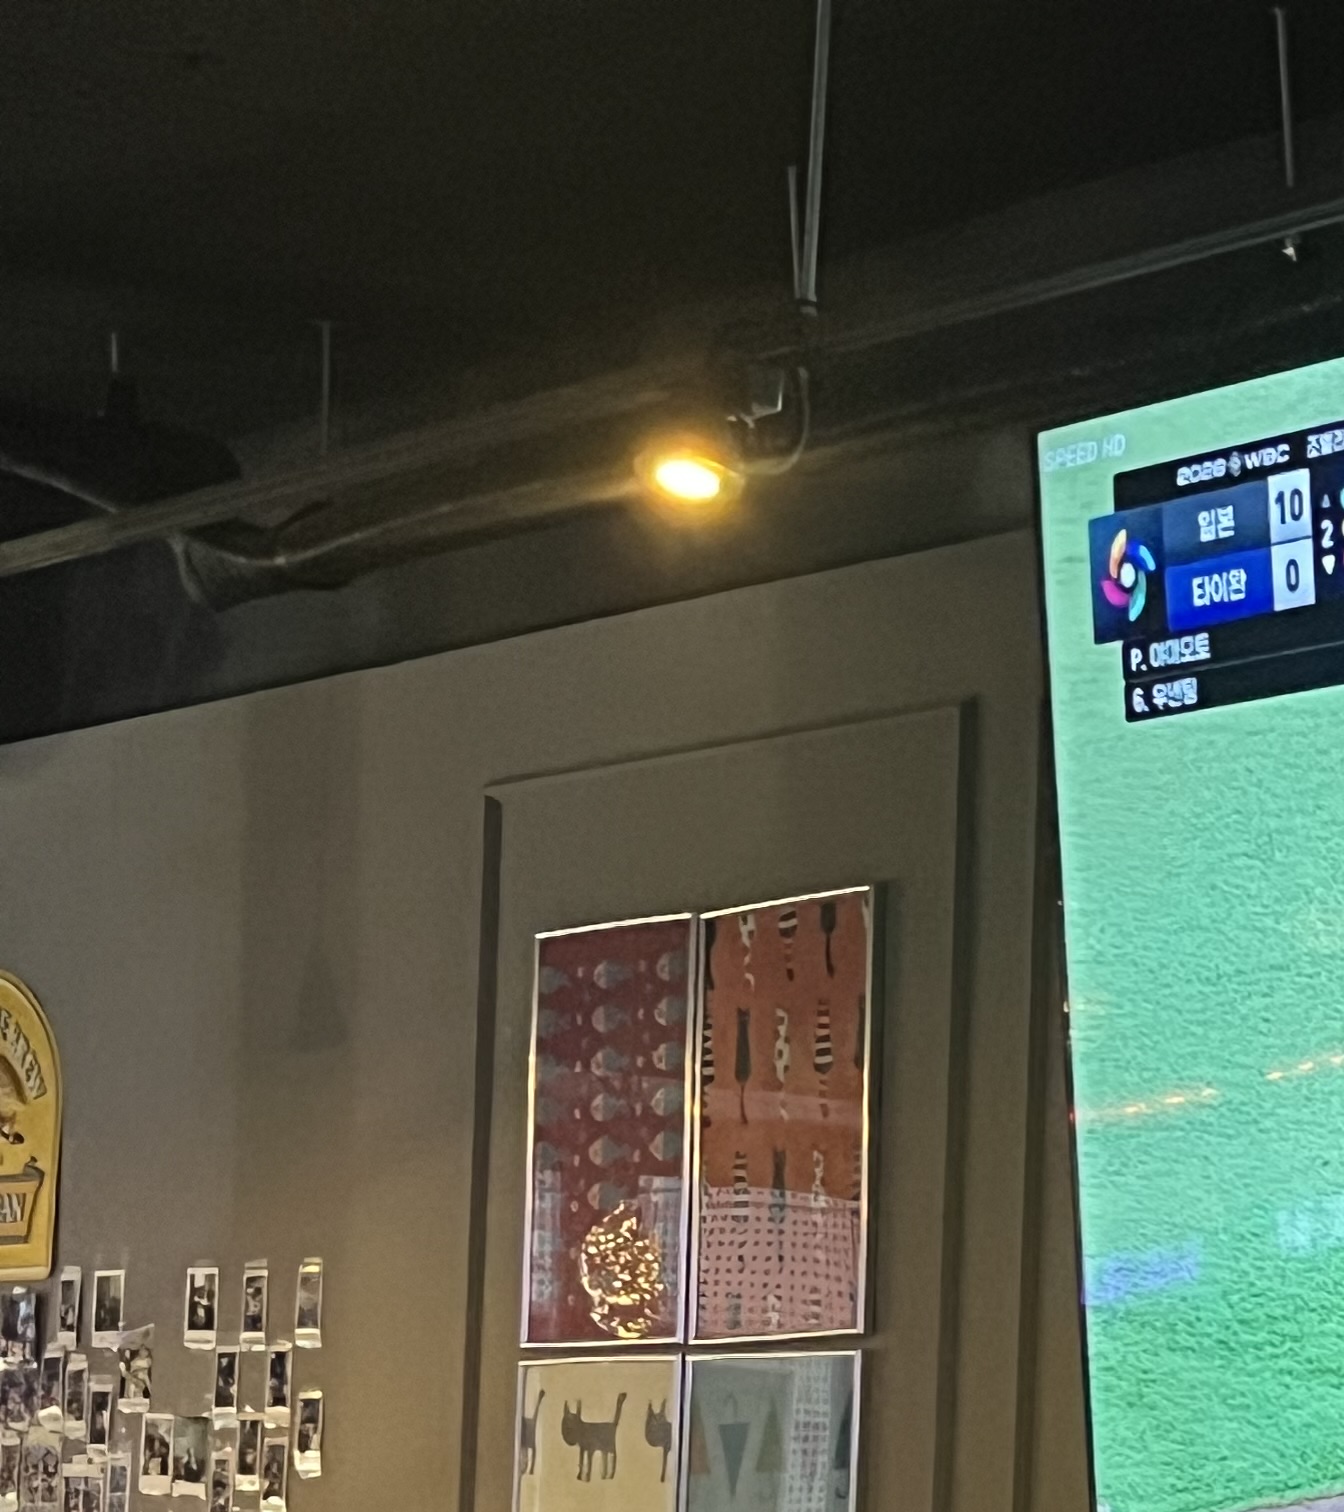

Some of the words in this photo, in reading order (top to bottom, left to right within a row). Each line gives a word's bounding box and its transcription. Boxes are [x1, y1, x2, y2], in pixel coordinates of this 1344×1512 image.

[1102, 433, 1126, 457] HD
[1244, 444, 1290, 469] WBC
[1275, 488, 1304, 524] 10
[1197, 505, 1235, 542] 일본
[1321, 519, 1334, 548] 2
[1192, 568, 1247, 607] 타이완
[1285, 558, 1300, 593] 0
[1130, 648, 1148, 671] P.
